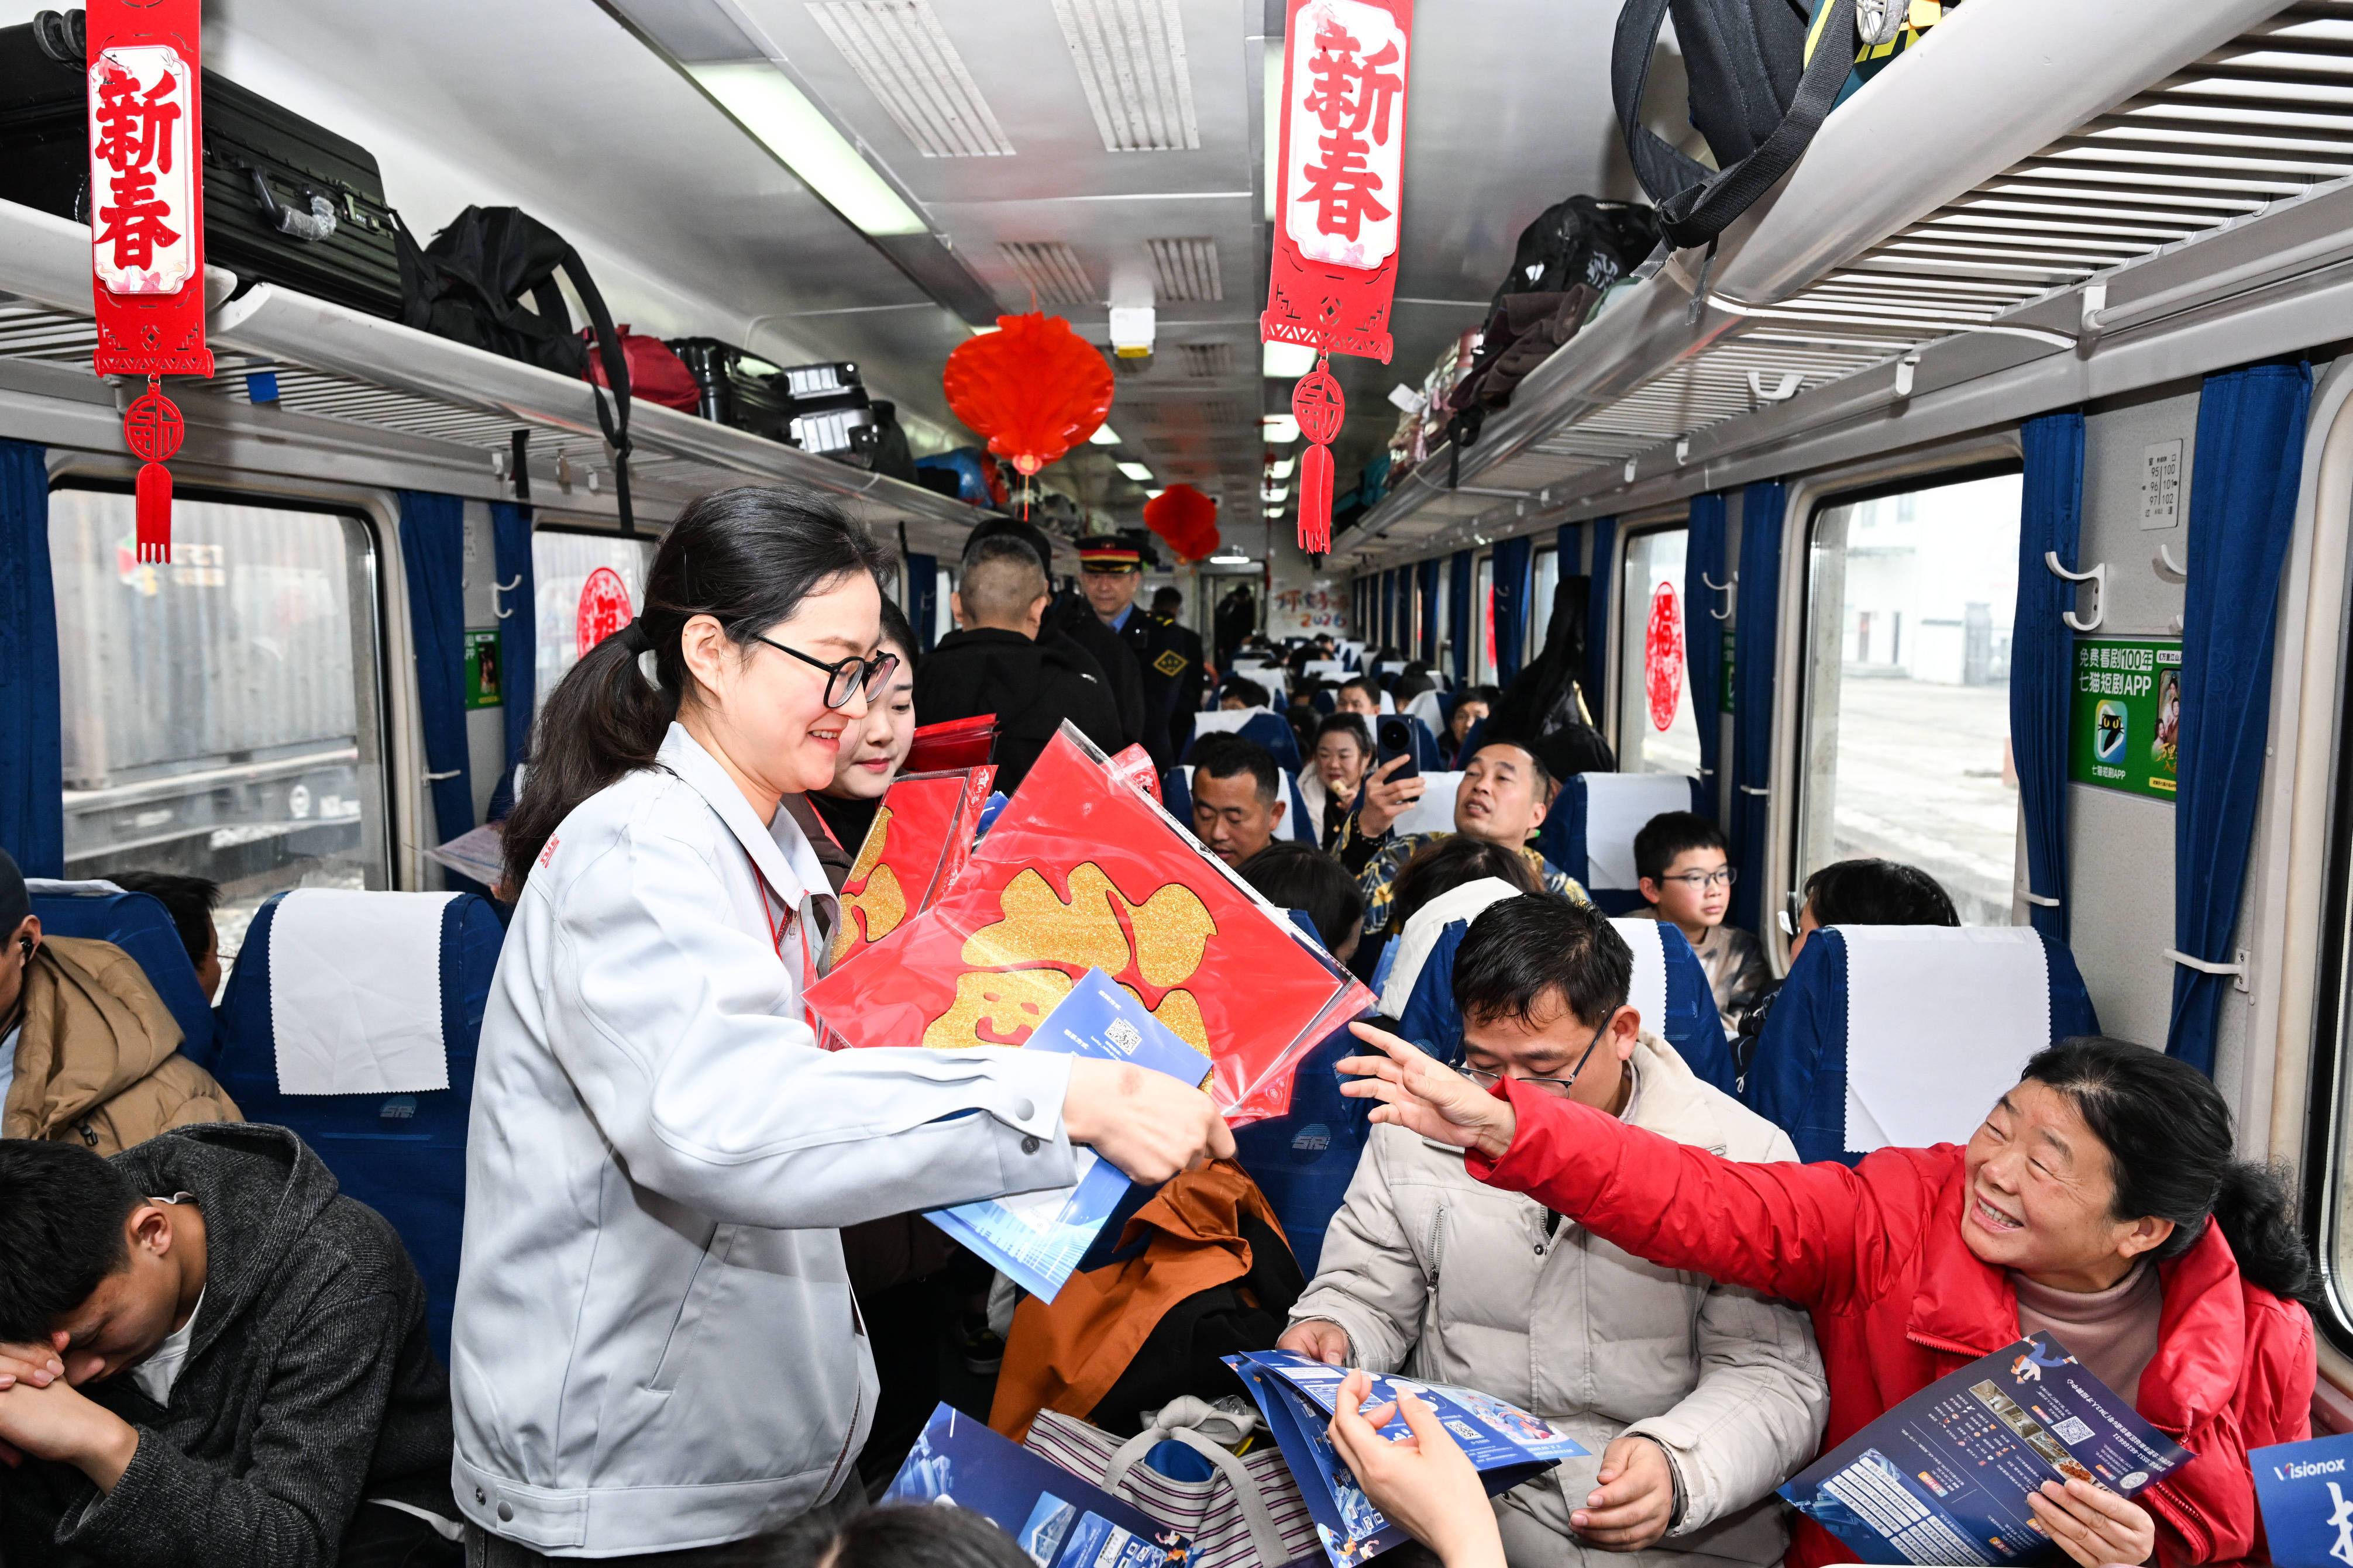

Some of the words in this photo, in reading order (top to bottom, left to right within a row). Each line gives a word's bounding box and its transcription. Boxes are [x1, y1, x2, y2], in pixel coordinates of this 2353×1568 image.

[1296, 20, 1402, 243] 新春
[94, 68, 181, 271] 新春
[2151, 466, 2159, 477] 95
[2163, 463, 2176, 475] 100
[2150, 481, 2158, 491] 96
[2163, 479, 2174, 491] 101
[2149, 495, 2158, 506] 97
[2162, 493, 2173, 505] 102
[2079, 647, 2154, 672] 免费看剧100年
[2079, 671, 2152, 697] 七猫短剧APP
[2091, 764, 2126, 780] 七猫短剧APP
[2273, 1458, 2345, 1481] Visionox
[1921, 1473, 1944, 1494] 工作时间
